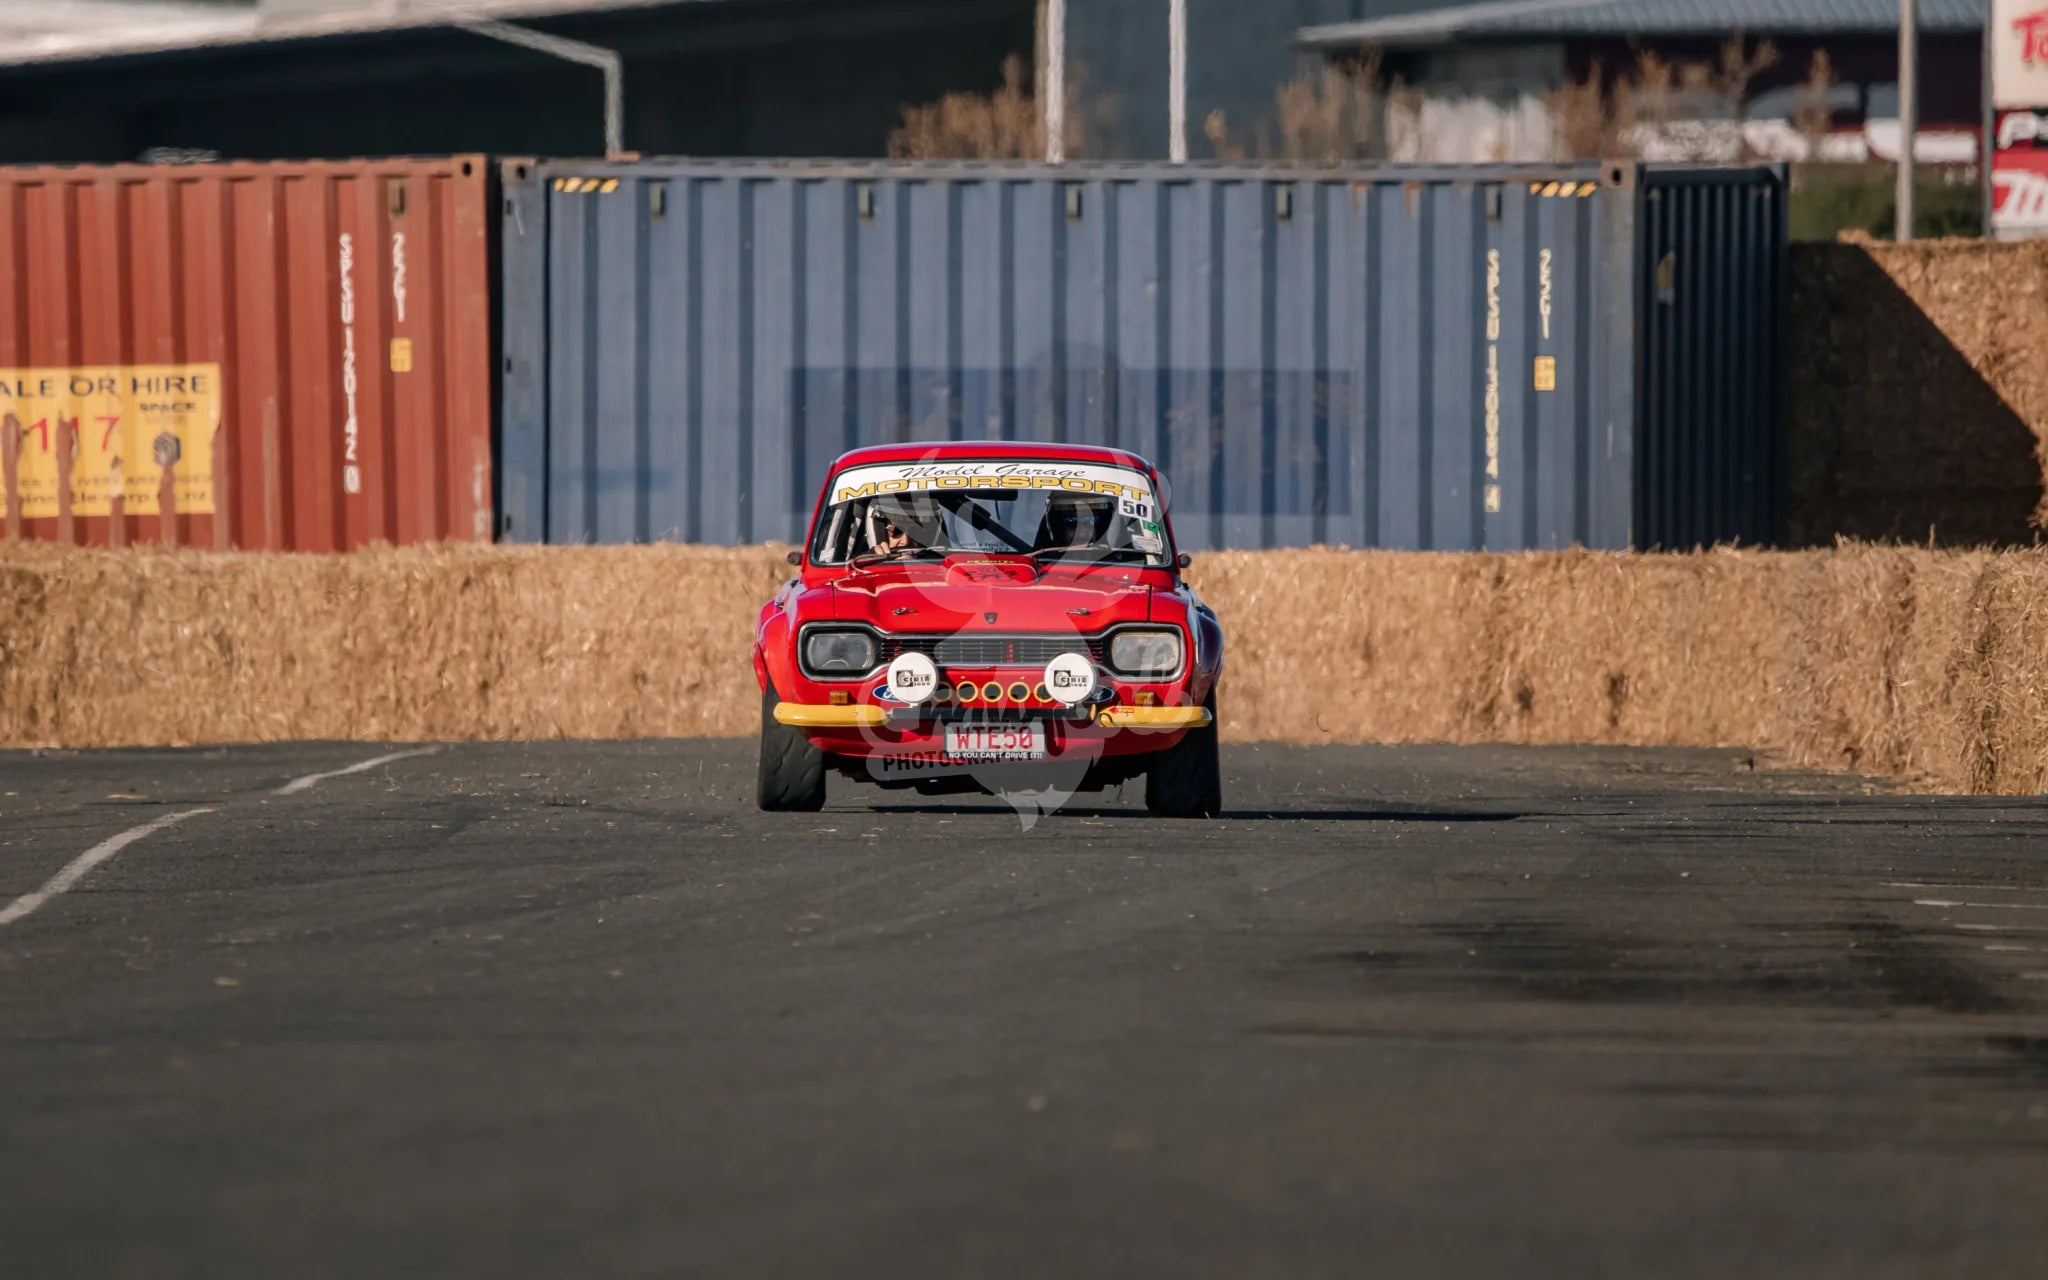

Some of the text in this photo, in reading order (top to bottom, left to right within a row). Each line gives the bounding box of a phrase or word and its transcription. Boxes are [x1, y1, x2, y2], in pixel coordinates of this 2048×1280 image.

[1486, 248, 1500, 340] SPSU
[69, 376, 118, 397] OR
[132, 375, 208, 395] HIRE
[899, 463, 1086, 480] Model Garage
[838, 475, 1150, 501] MOTORSPORT
[1122, 500, 1148, 518] 50
[956, 726, 1033, 750] WTE50
[948, 751, 960, 759] NO
[962, 751, 978, 759] YOU
[980, 751, 1003, 759] CAN'T
[1005, 751, 1028, 759] DRIVE
